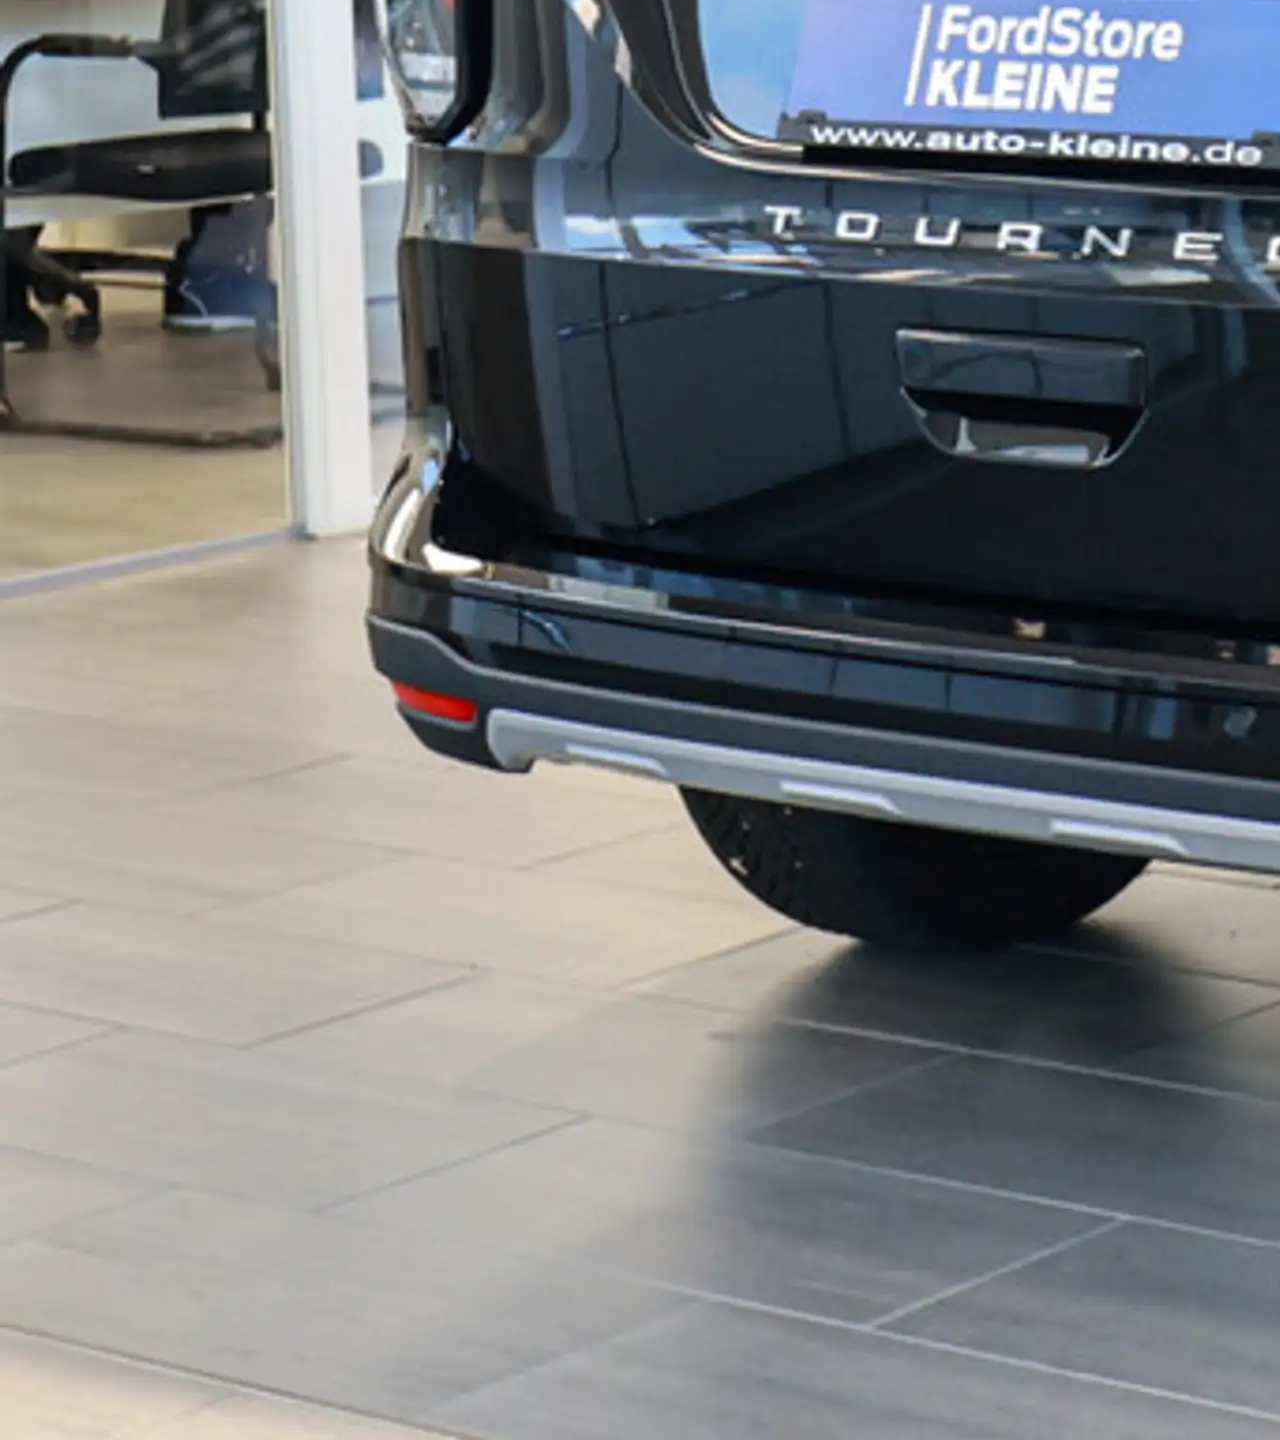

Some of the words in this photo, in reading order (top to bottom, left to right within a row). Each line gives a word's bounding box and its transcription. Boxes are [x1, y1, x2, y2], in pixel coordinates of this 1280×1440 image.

[935, 2, 1184, 60] FordStore
[925, 60, 1119, 115] KLEINE
[809, 123, 1264, 167] www.auto-kleine.de
